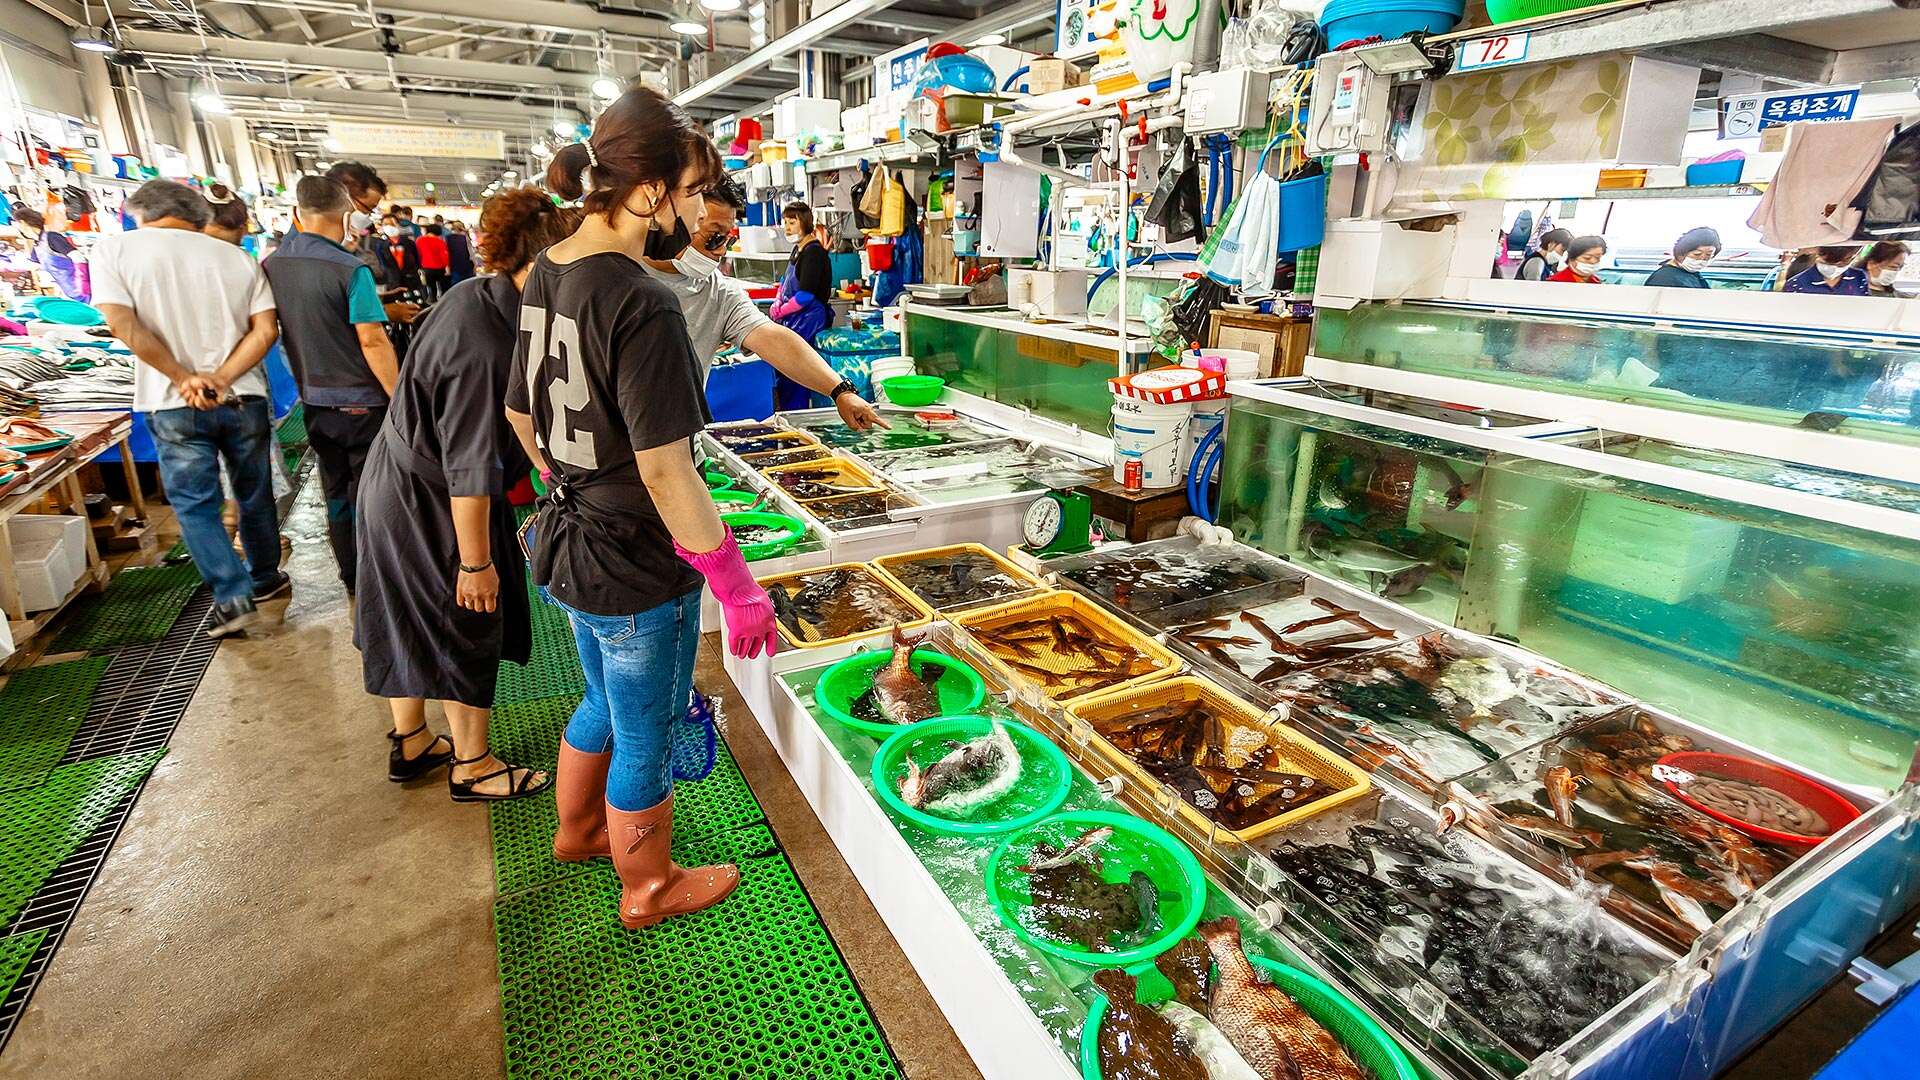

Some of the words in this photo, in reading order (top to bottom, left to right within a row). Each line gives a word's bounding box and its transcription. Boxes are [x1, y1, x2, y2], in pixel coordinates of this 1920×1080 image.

[1480, 37, 1509, 62] 72
[1768, 94, 1852, 117] 옥화조개
[520, 305, 598, 469] 72
